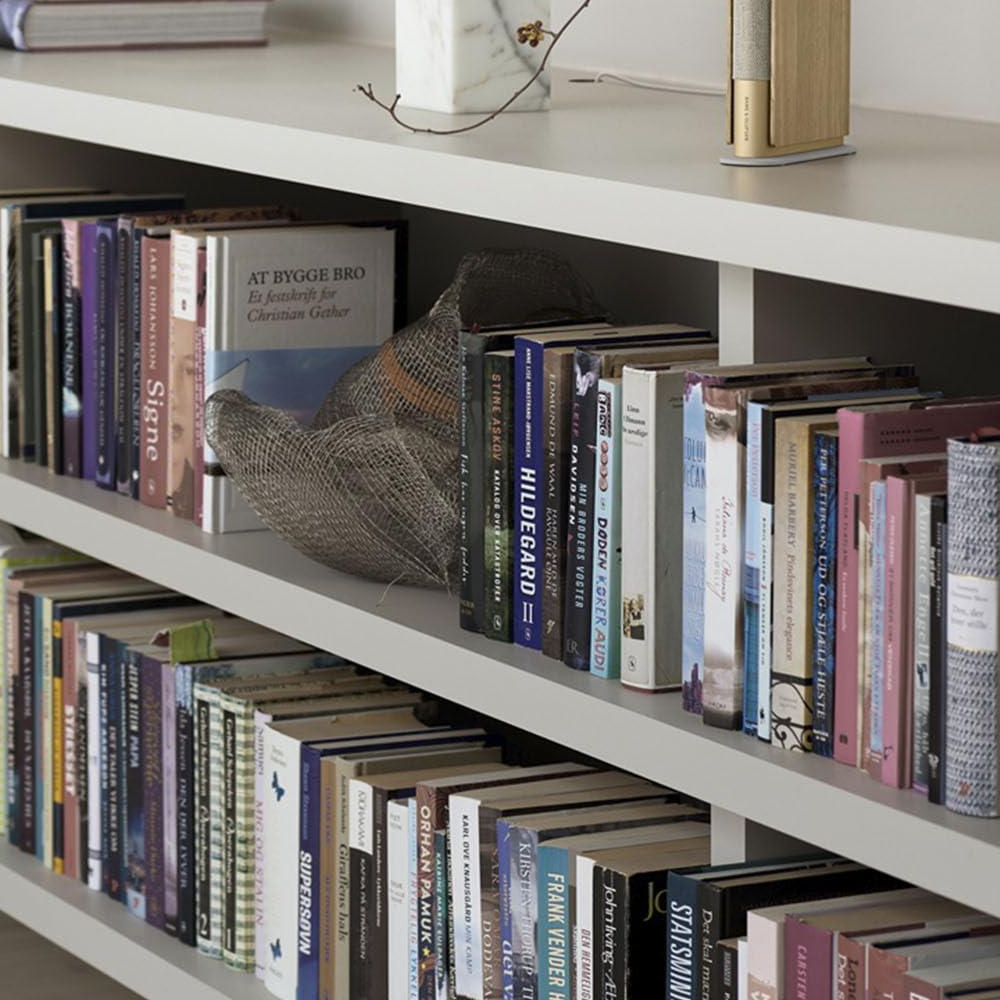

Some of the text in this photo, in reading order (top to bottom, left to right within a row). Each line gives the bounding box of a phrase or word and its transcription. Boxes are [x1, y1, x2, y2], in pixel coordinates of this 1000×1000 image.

[148, 248, 158, 370] LARS JOHANSSON
[247, 305, 350, 322] Christian Gether
[248, 266, 366, 285] AT BYGGE BRO
[248, 290, 263, 304] Et
[264, 287, 317, 305] festskrift
[143, 378, 164, 462] Signe
[491, 373, 503, 461] STINE ASKOV
[548, 374, 557, 500] EDMUND DE WAAL
[568, 444, 579, 525] DAVIDSEN
[577, 483, 586, 505] MIN
[787, 442, 797, 547] MURIEL BARBERY
[493, 469, 501, 603] KATALOG OVER KATASTROFER
[520, 467, 536, 624] HILDEGARD II
[575, 566, 585, 608] VOGTER
[594, 517, 608, 671] DØDEN KØRER AUDI
[784, 554, 796, 662] Pindsvinets elegance
[815, 448, 828, 720] PER PETTERSON UD OG STJÆLE HESTE
[129, 664, 140, 768] JESPER STEIN PAPA
[299, 851, 313, 955] SUPERSØVN
[337, 843, 348, 943] Giraffens hals
[359, 858, 367, 889] KAFKA
[420, 805, 432, 944] ORHAN PAMUK
[462, 814, 472, 923] KARL OVE KNAUSGÅRD
[519, 842, 532, 906] KIRSTEN
[547, 872, 566, 924] FRANK
[603, 885, 618, 923] John
[200, 913, 207, 935] 2
[520, 915, 534, 976] THORUP
[548, 928, 566, 987] VENDER
[581, 928, 591, 948] DEN
[702, 908, 714, 964] Det skal
[796, 945, 808, 1000] CARSTEN
